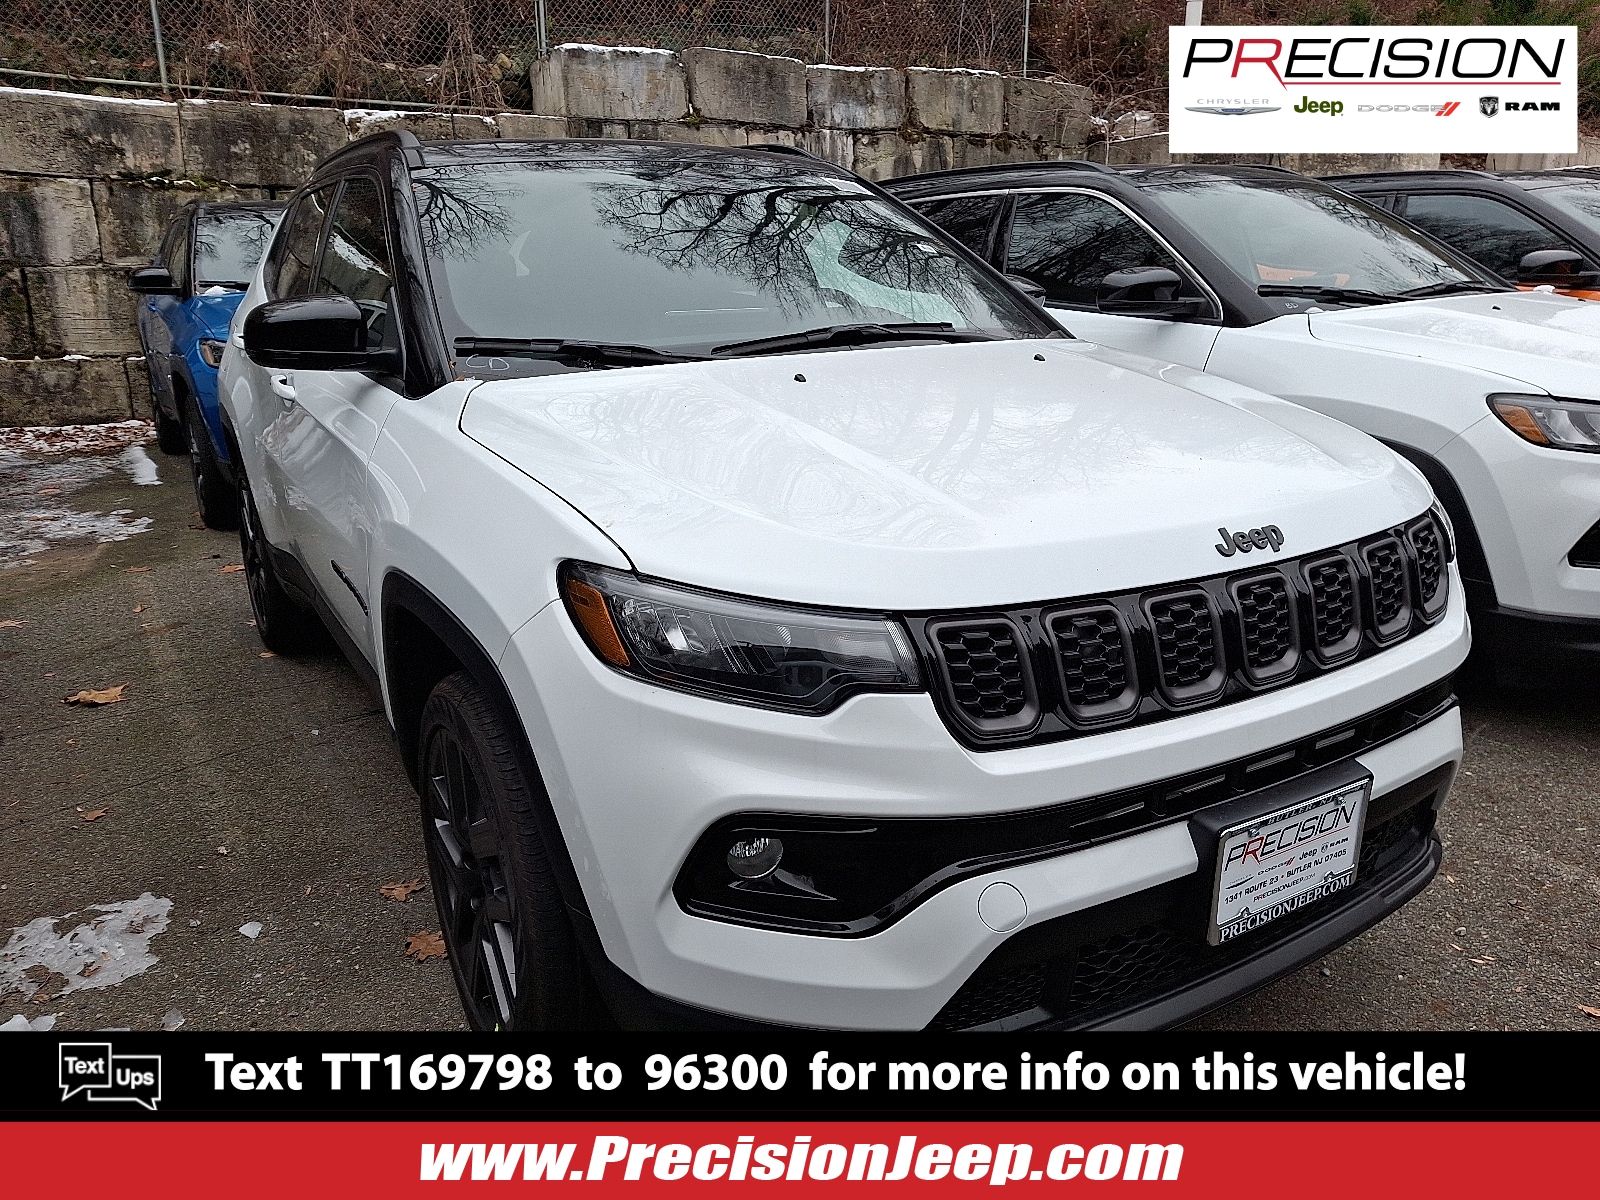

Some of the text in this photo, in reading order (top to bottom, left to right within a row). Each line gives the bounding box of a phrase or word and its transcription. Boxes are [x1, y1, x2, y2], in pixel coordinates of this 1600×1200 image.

[1214, 524, 1285, 558] Jeep
[1224, 800, 1357, 872] PRECISION
[1299, 848, 1318, 861] Jeep
[1329, 837, 1349, 848] RAM
[1224, 891, 1243, 905] 1341
[1244, 880, 1268, 896] ROUTE
[1286, 861, 1312, 878] BUTLER
[1313, 857, 1324, 867] NJ
[1324, 848, 1347, 863] 07405
[1219, 874, 1352, 943] PRECISIONJEEP.COM
